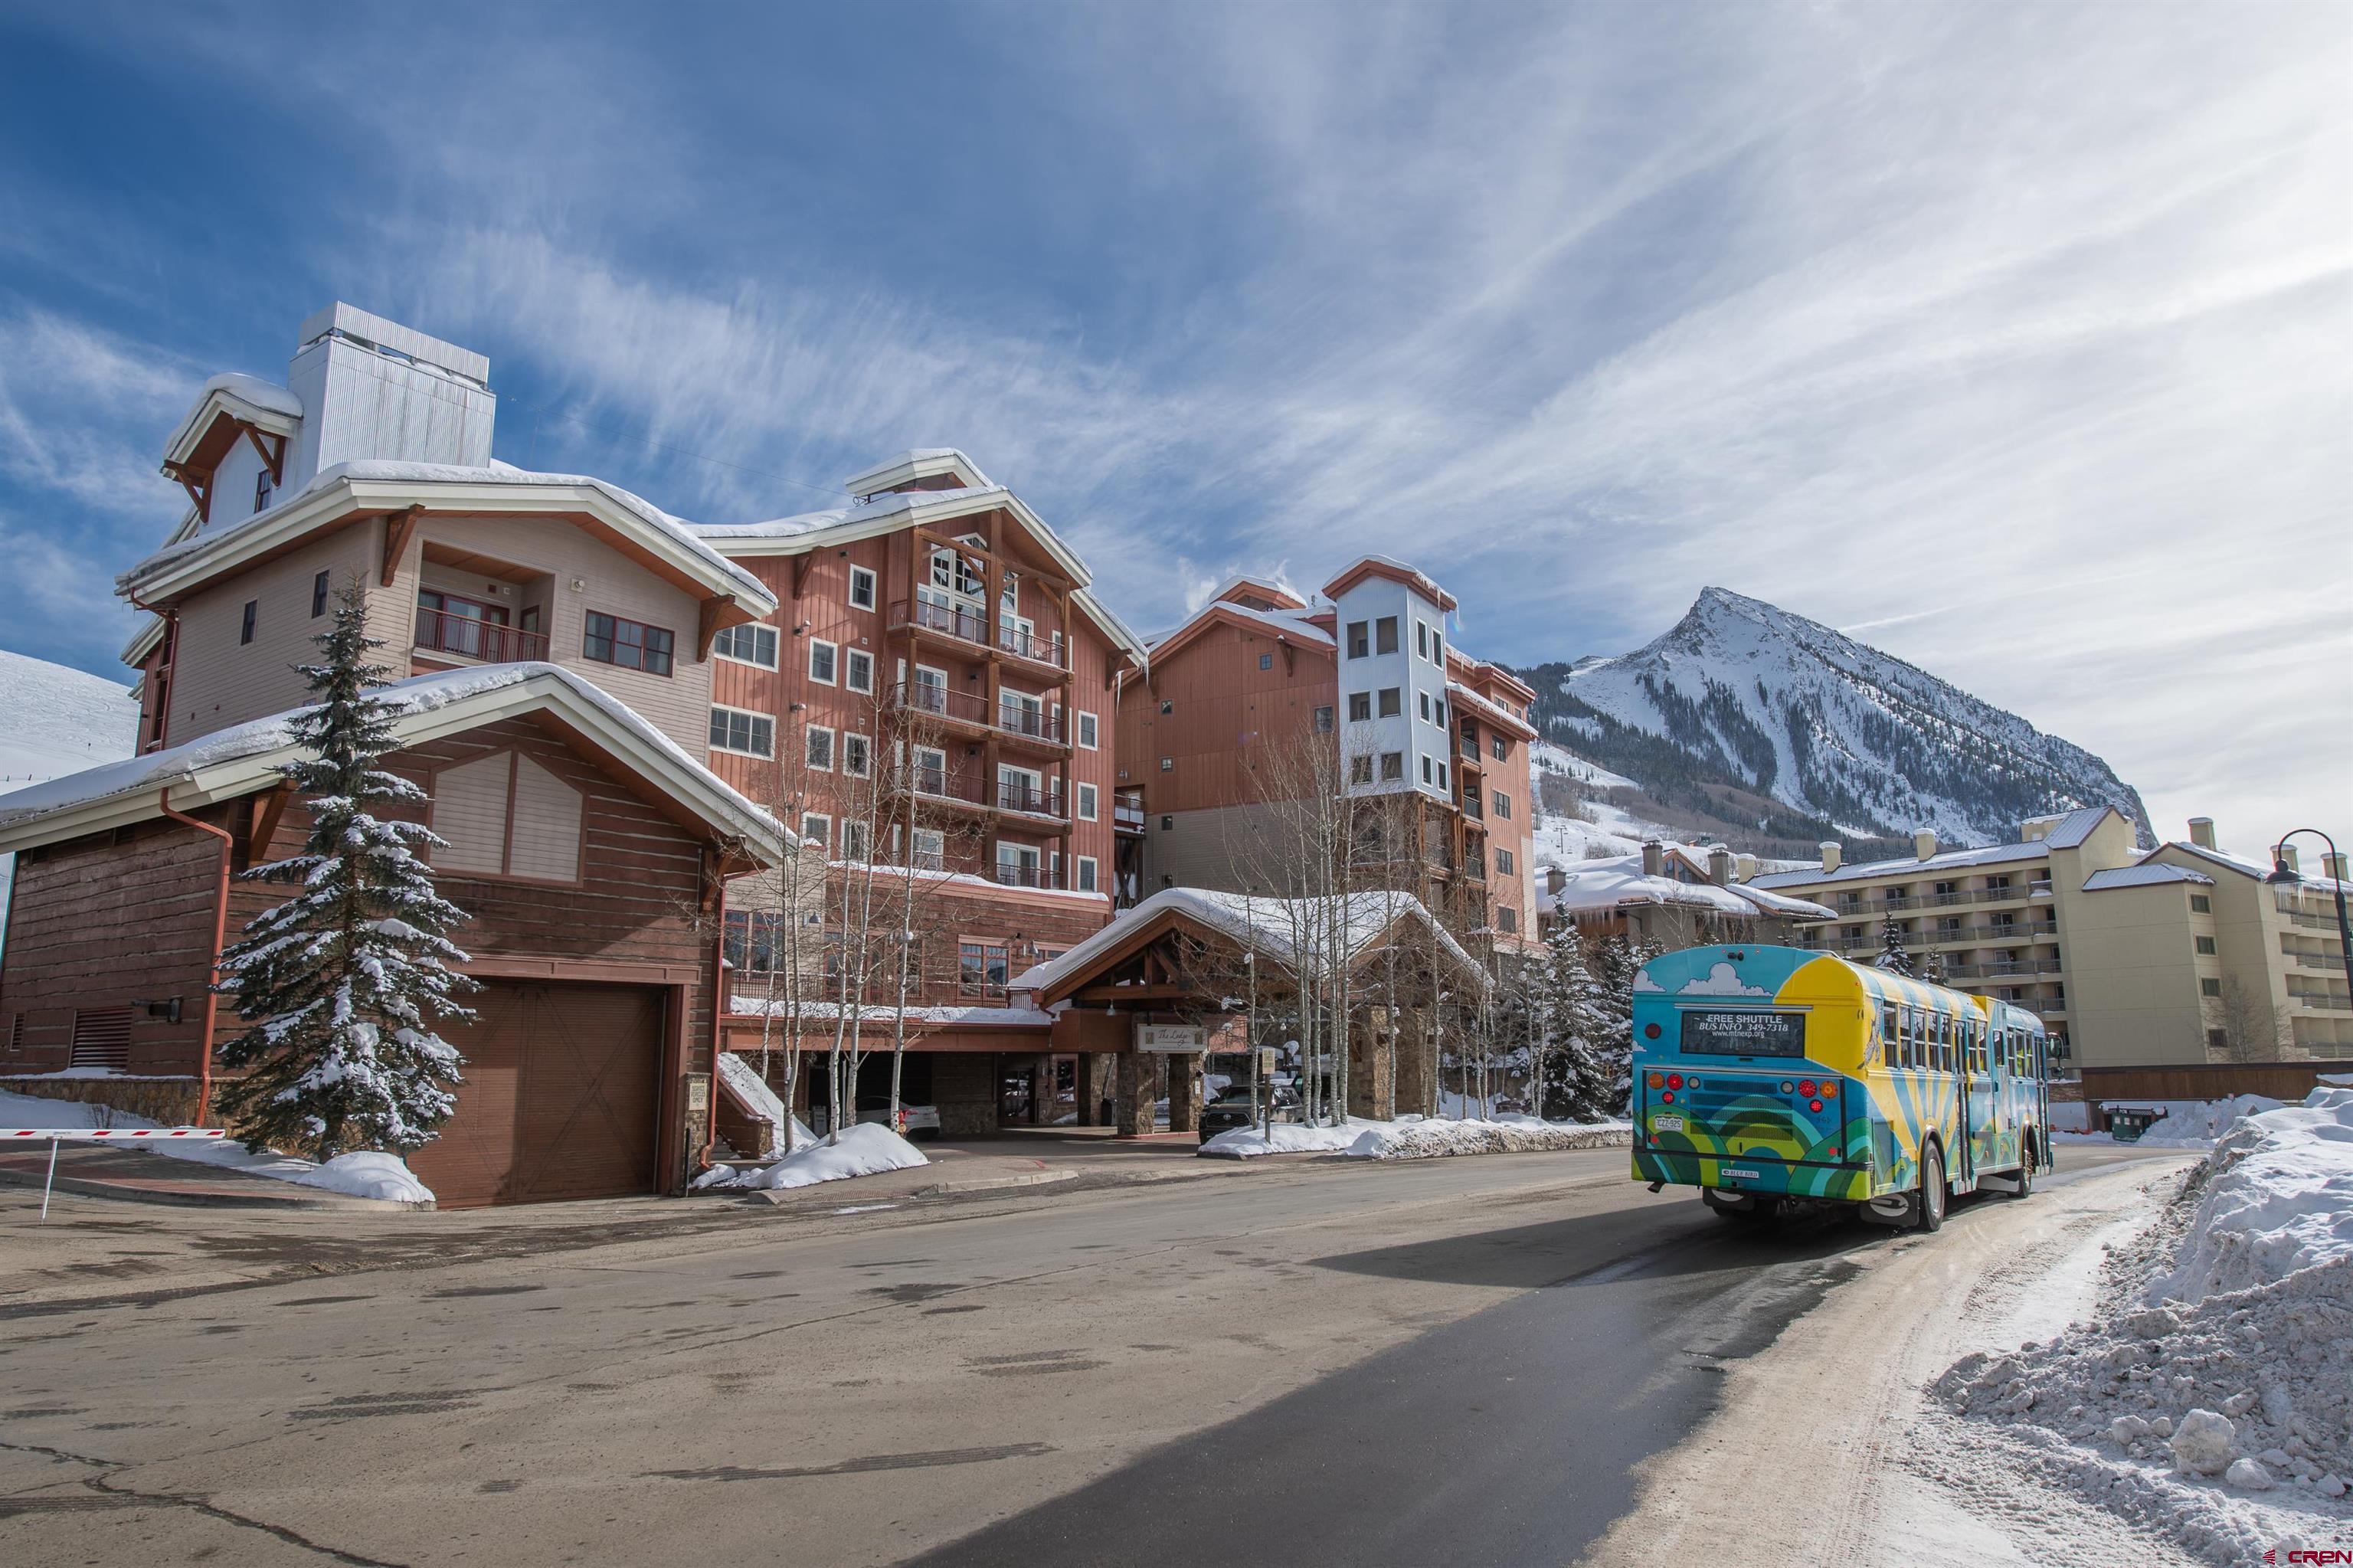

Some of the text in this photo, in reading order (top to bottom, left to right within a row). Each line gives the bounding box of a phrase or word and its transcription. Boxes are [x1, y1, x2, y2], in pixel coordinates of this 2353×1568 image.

[1707, 1014, 1782, 1023] FREE SHUTTLE
[1746, 1023, 1788, 1032] 349-7318
[1712, 1030, 1765, 1039] www.mtnexp.org
